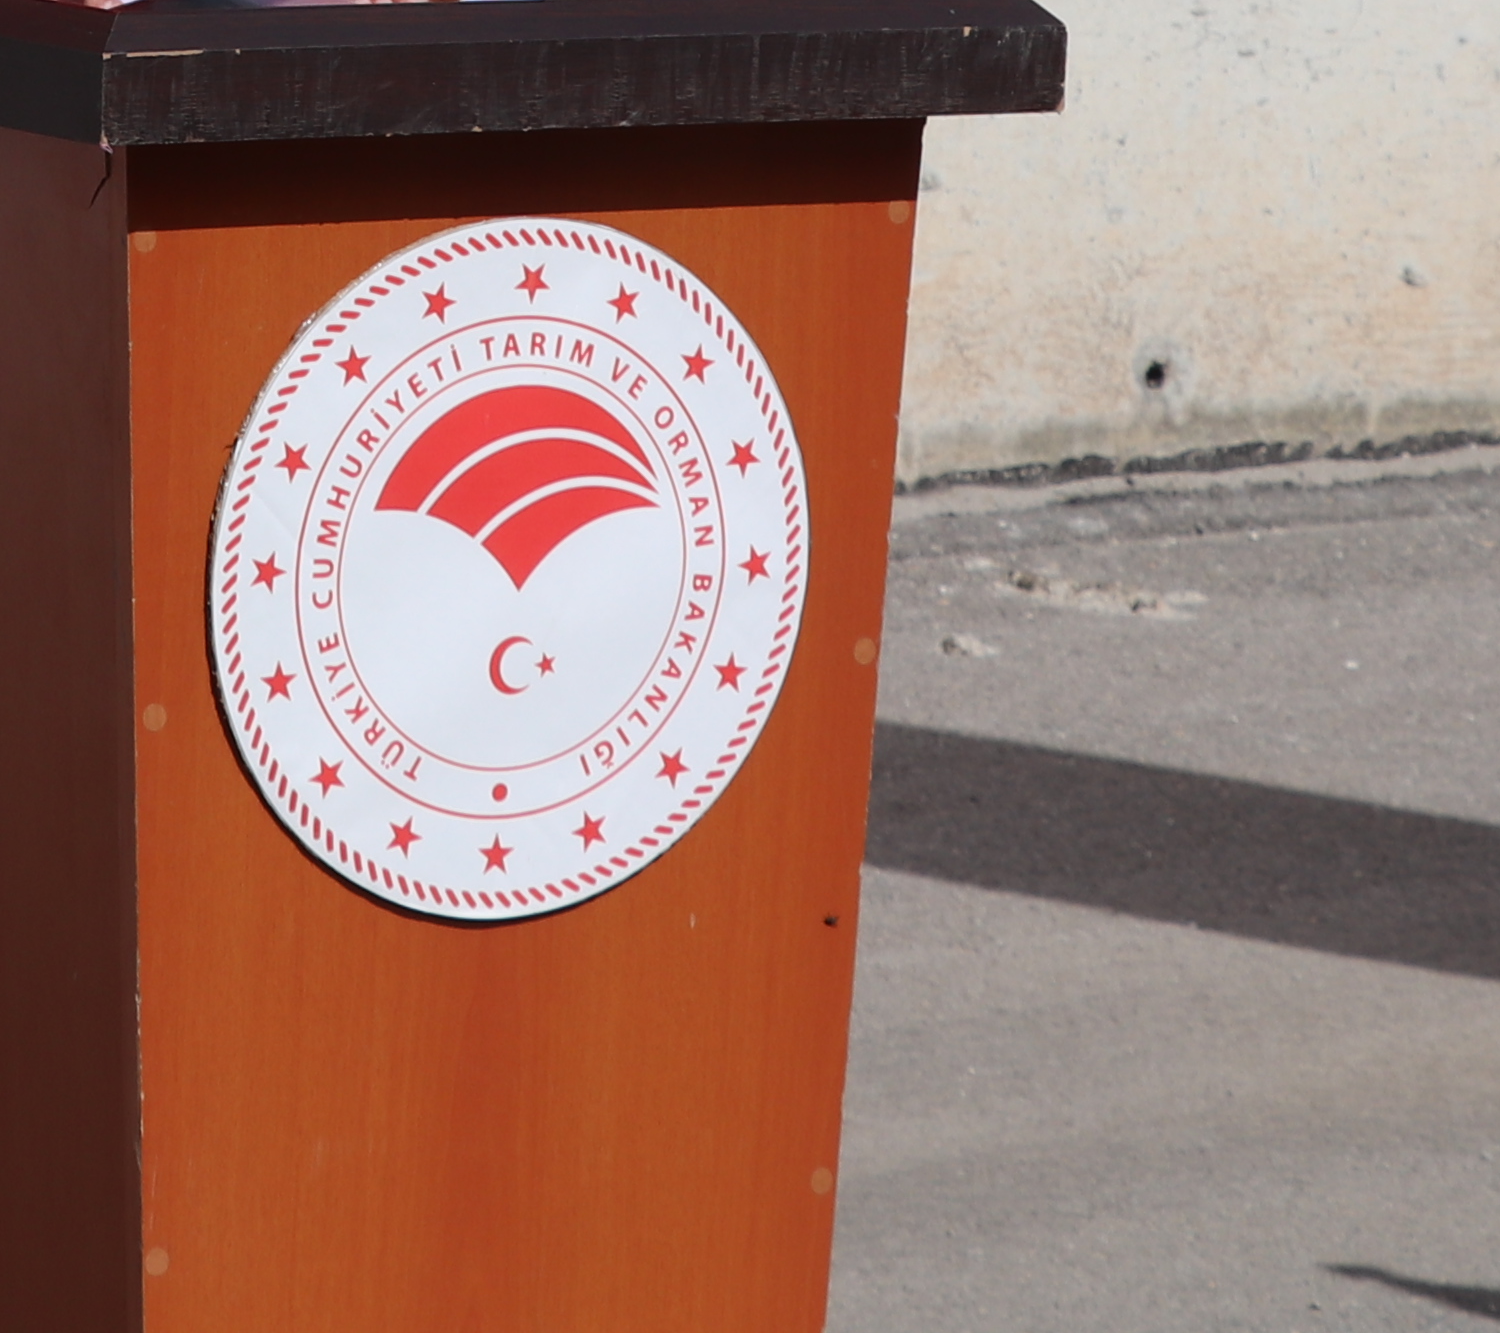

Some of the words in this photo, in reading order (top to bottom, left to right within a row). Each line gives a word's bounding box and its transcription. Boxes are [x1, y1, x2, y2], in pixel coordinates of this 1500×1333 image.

[479, 332, 595, 368] TARIM
[611, 357, 649, 400] VE
[312, 343, 463, 609] CUMHURİYETİ
[654, 406, 715, 548] ORMAN
[317, 632, 422, 781] TÜRKİYE
[579, 573, 713, 777] BAKANLIĞI
